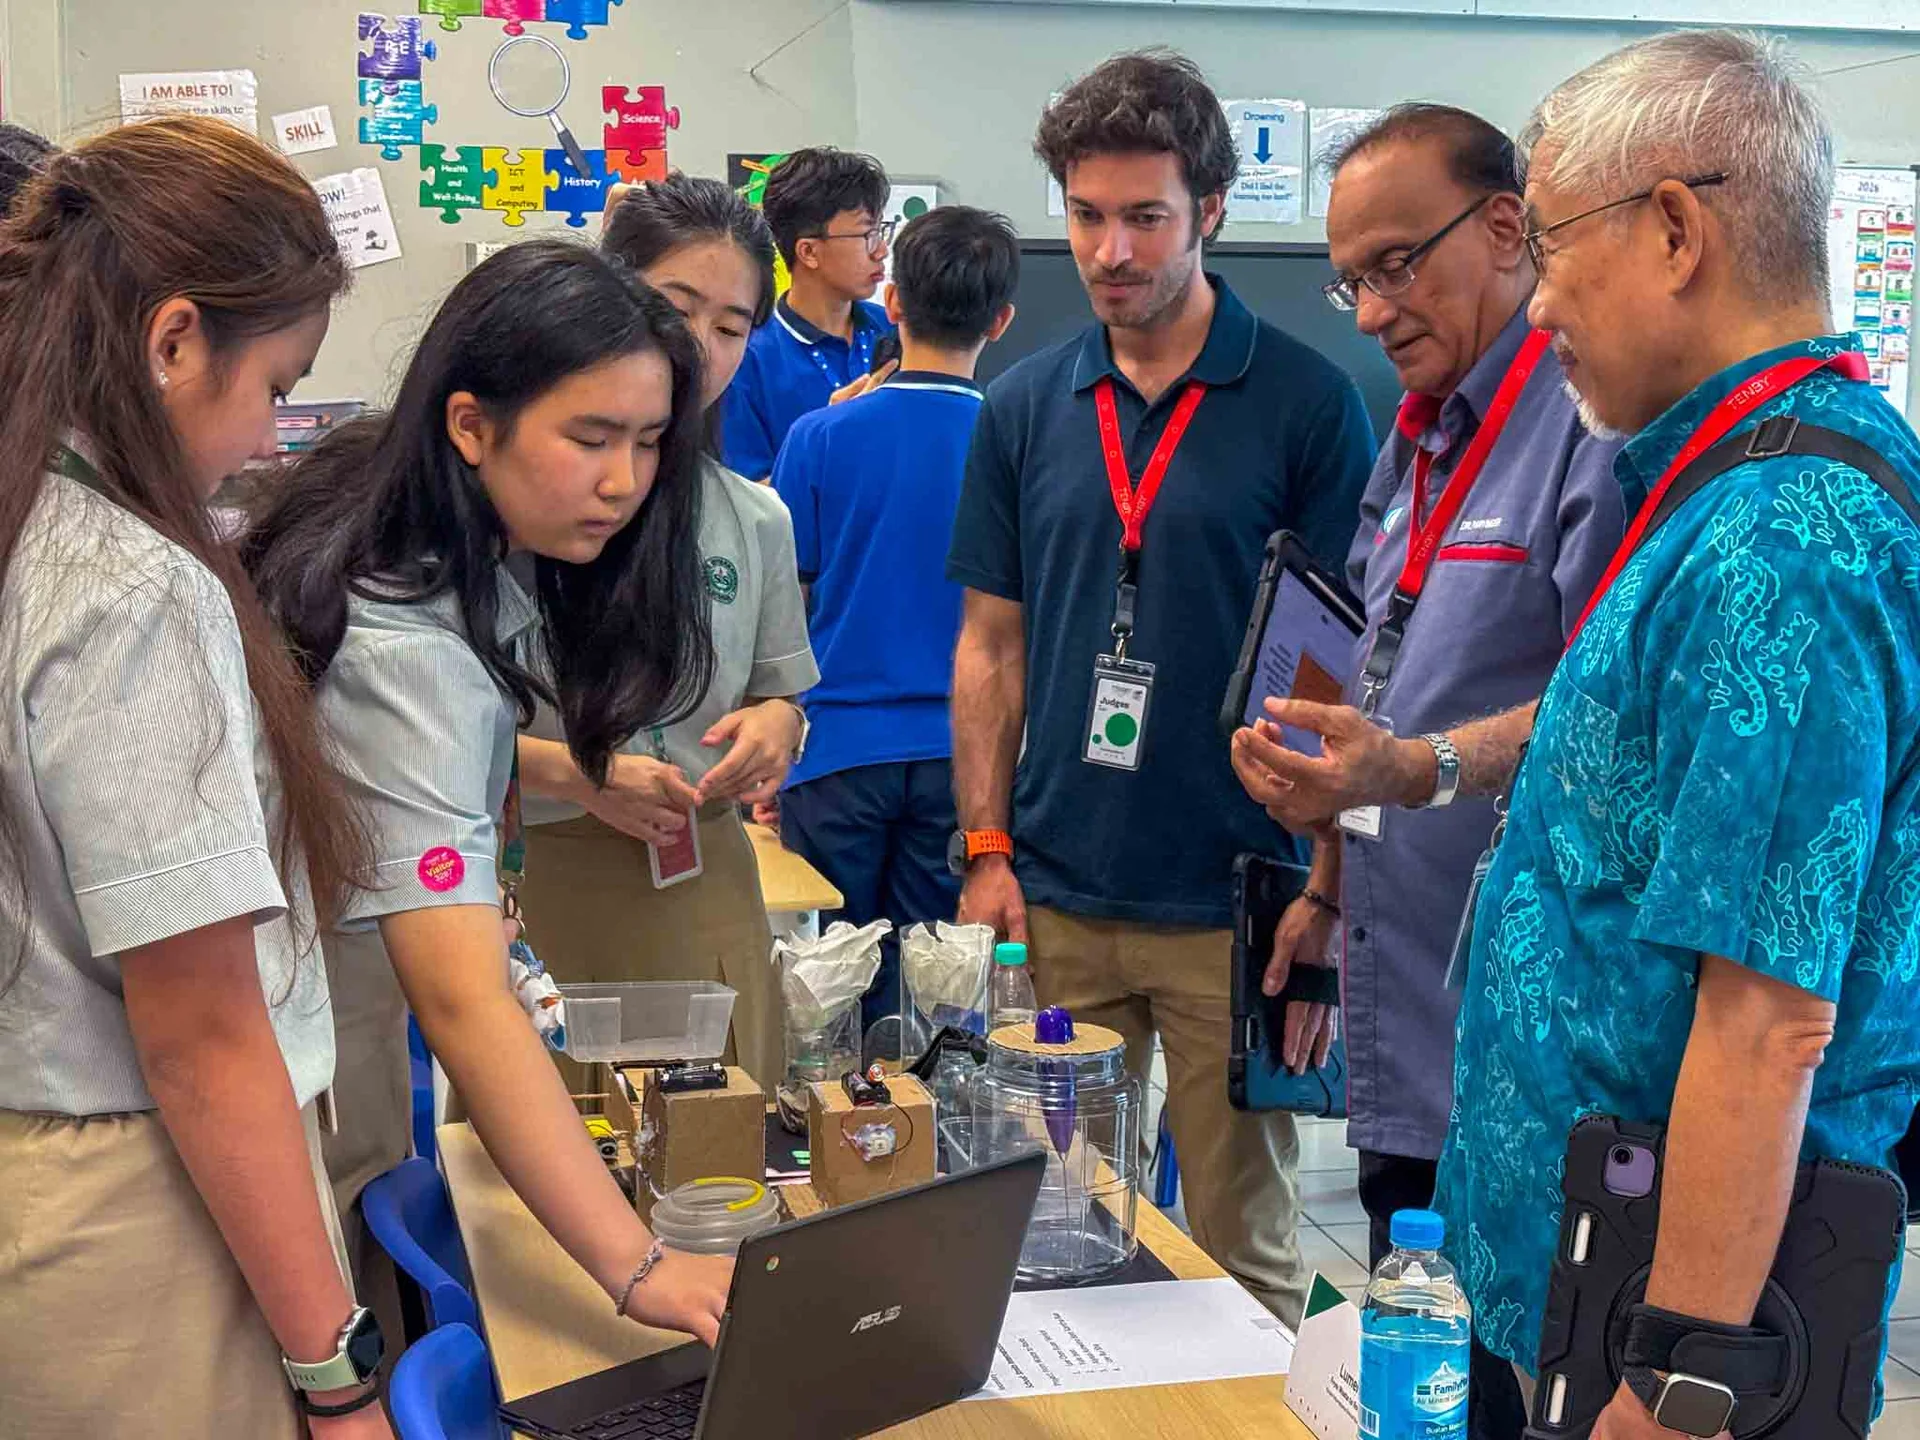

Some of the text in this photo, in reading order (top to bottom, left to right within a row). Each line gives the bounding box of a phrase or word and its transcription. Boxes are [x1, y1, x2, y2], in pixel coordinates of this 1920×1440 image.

[150, 86, 173, 98] AM
[176, 85, 208, 98] ABLE
[622, 113, 662, 124] Science
[1243, 112, 1285, 124] Drowning
[285, 122, 325, 140] SKILL
[441, 165, 469, 174] Health
[447, 179, 463, 188] and
[509, 184, 525, 193] and
[564, 176, 602, 188] History
[319, 188, 345, 205] OW!
[496, 199, 539, 209] Computing
[1726, 375, 1770, 411] TENBY
[1100, 696, 1131, 710] Judges
[425, 859, 455, 878] Visitor
[850, 1305, 902, 1335] ASUS
[1340, 1363, 1359, 1393] Lume
